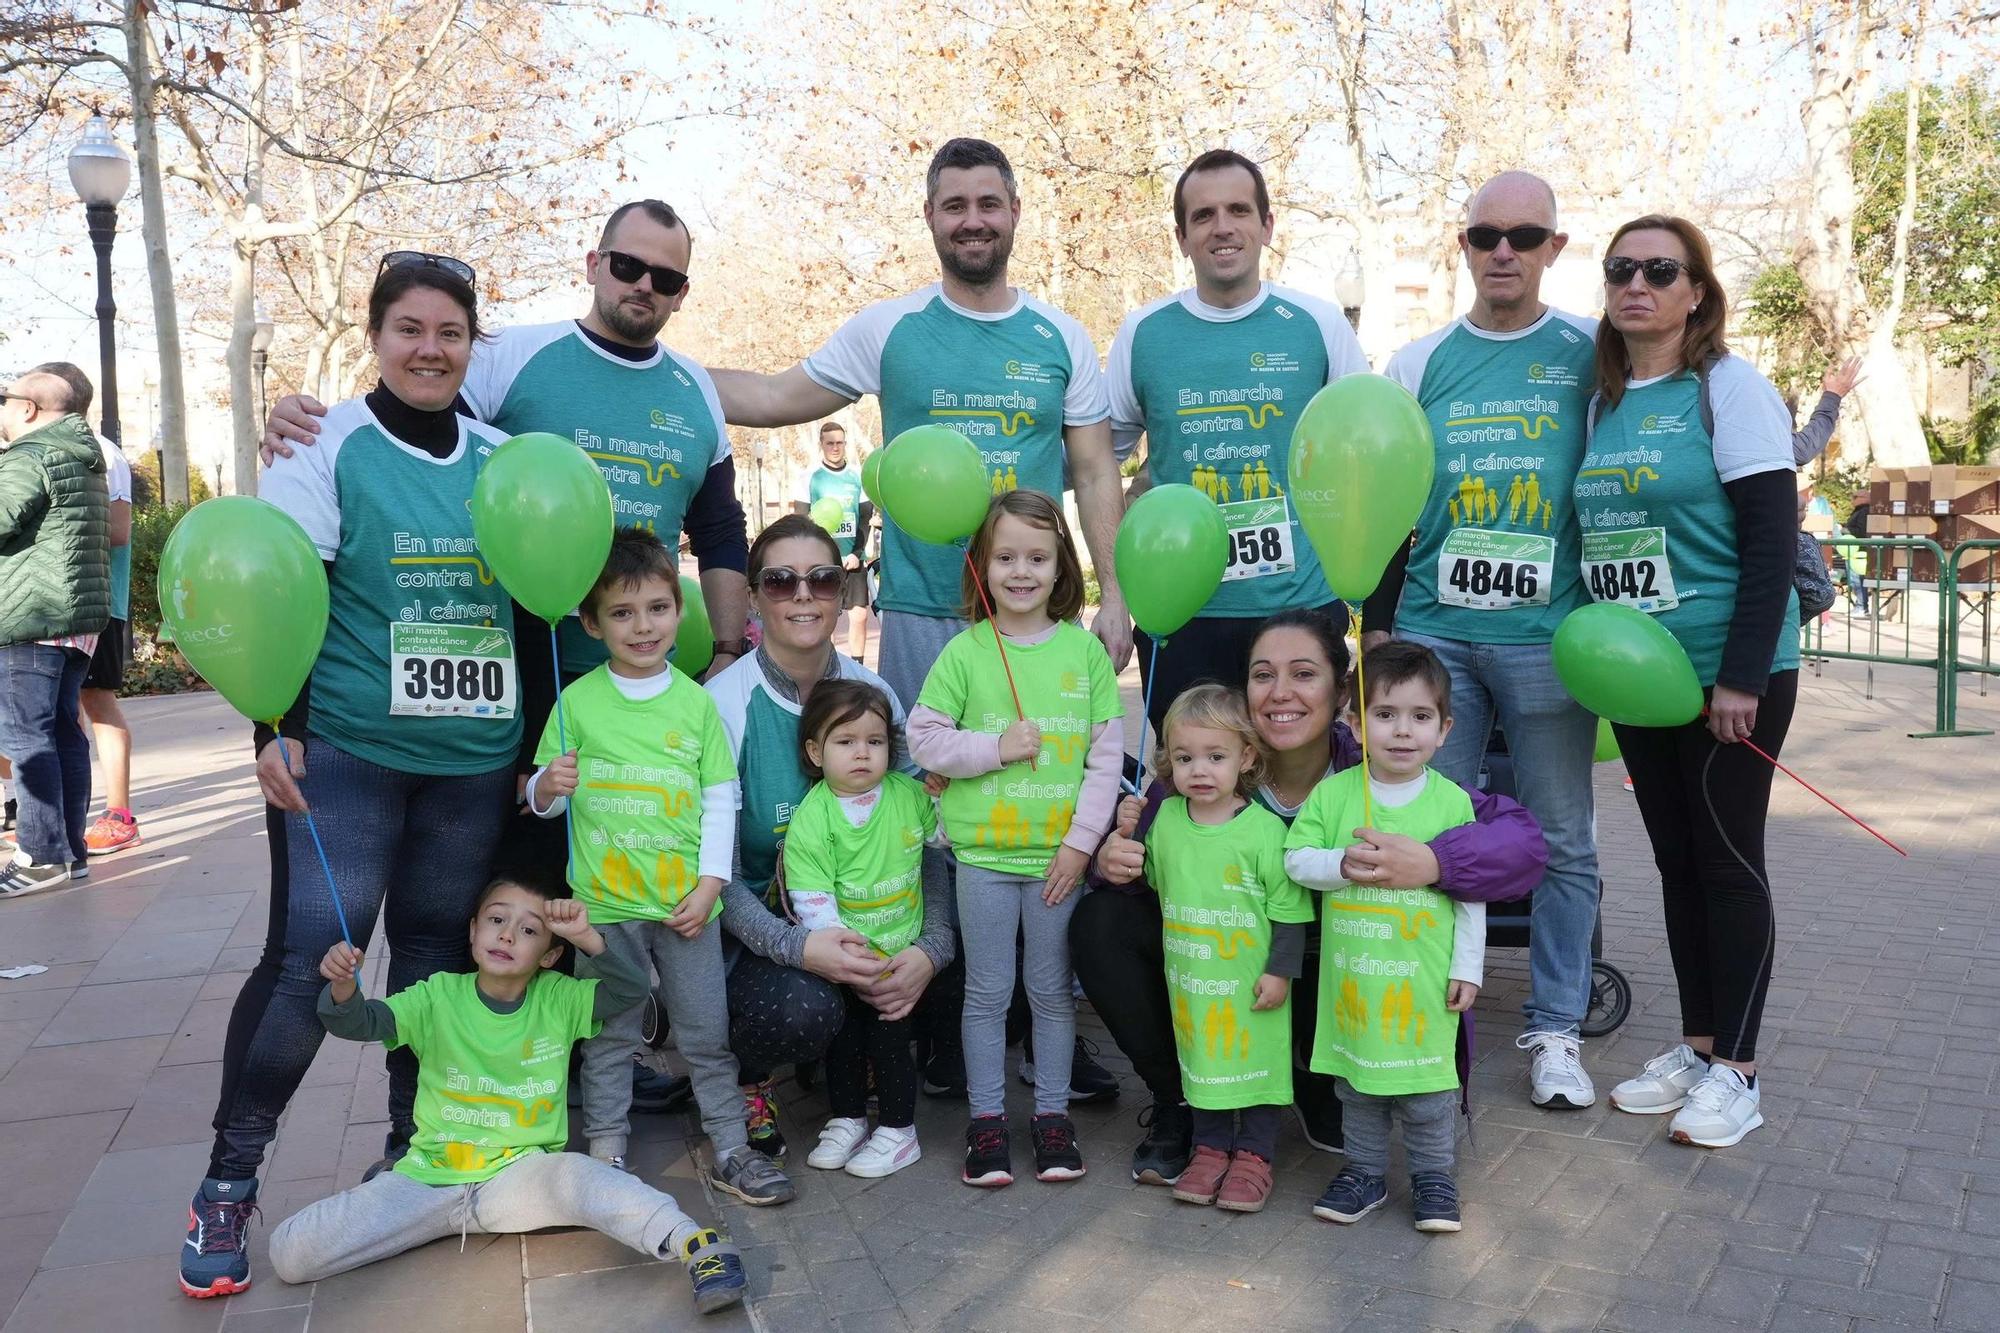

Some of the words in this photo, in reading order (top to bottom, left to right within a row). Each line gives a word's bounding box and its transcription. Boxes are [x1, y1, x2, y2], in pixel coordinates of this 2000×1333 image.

[932, 389, 958, 407] En
[964, 390, 1036, 409] marcha
[1178, 388, 1203, 406] En
[1209, 382, 1283, 403] marcha
[1449, 400, 1475, 418] En
[1482, 394, 1559, 413] marcha
[1180, 416, 1244, 434] contra
[1446, 426, 1517, 444] contra
[575, 428, 602, 450] En
[609, 436, 683, 463] marcha
[1182, 443, 1198, 462] el
[1204, 442, 1271, 460] cáncer
[1447, 453, 1466, 473] el
[1473, 453, 1544, 470] cáncer
[1582, 452, 1599, 469] En
[1600, 445, 1663, 467] marcha
[1574, 480, 1622, 498] contra
[612, 493, 662, 518] áncer
[1580, 508, 1592, 528] el
[1594, 508, 1648, 527] cáncer
[393, 532, 427, 554] En
[1450, 539, 1472, 547] contra
[1482, 542, 1509, 550] cáncer
[1462, 532, 1491, 541] marcha
[1458, 548, 1489, 557] Castelló
[396, 568, 474, 588] contra
[1450, 558, 1538, 599] 4846
[1590, 560, 1660, 601] 4842
[400, 599, 422, 622] el
[429, 600, 498, 621] cáncer
[182, 624, 232, 642] aecc
[399, 636, 428, 645] contra
[429, 637, 439, 645] el
[440, 638, 468, 646] cáncer
[415, 627, 448, 636] marcha
[412, 645, 449, 655] Castelló
[404, 658, 504, 702] 3980
[1030, 711, 1087, 733] archa
[590, 758, 615, 779] En
[621, 763, 695, 790] marcha
[981, 775, 999, 796] el
[1004, 778, 1075, 799] cáncer
[587, 796, 657, 817] contra
[589, 824, 608, 846] el
[614, 828, 685, 850] cáncer
[1357, 886, 1439, 909] marcha
[1181, 904, 1257, 928] marcha
[1332, 918, 1394, 940] contra
[1165, 936, 1212, 960] contra
[1334, 947, 1346, 970] el
[1349, 952, 1420, 977] cáncer
[1180, 971, 1240, 996] cáncer
[446, 1066, 471, 1092] En
[1206, 1076, 1236, 1085] CONTRA
[440, 1104, 512, 1128] contra
